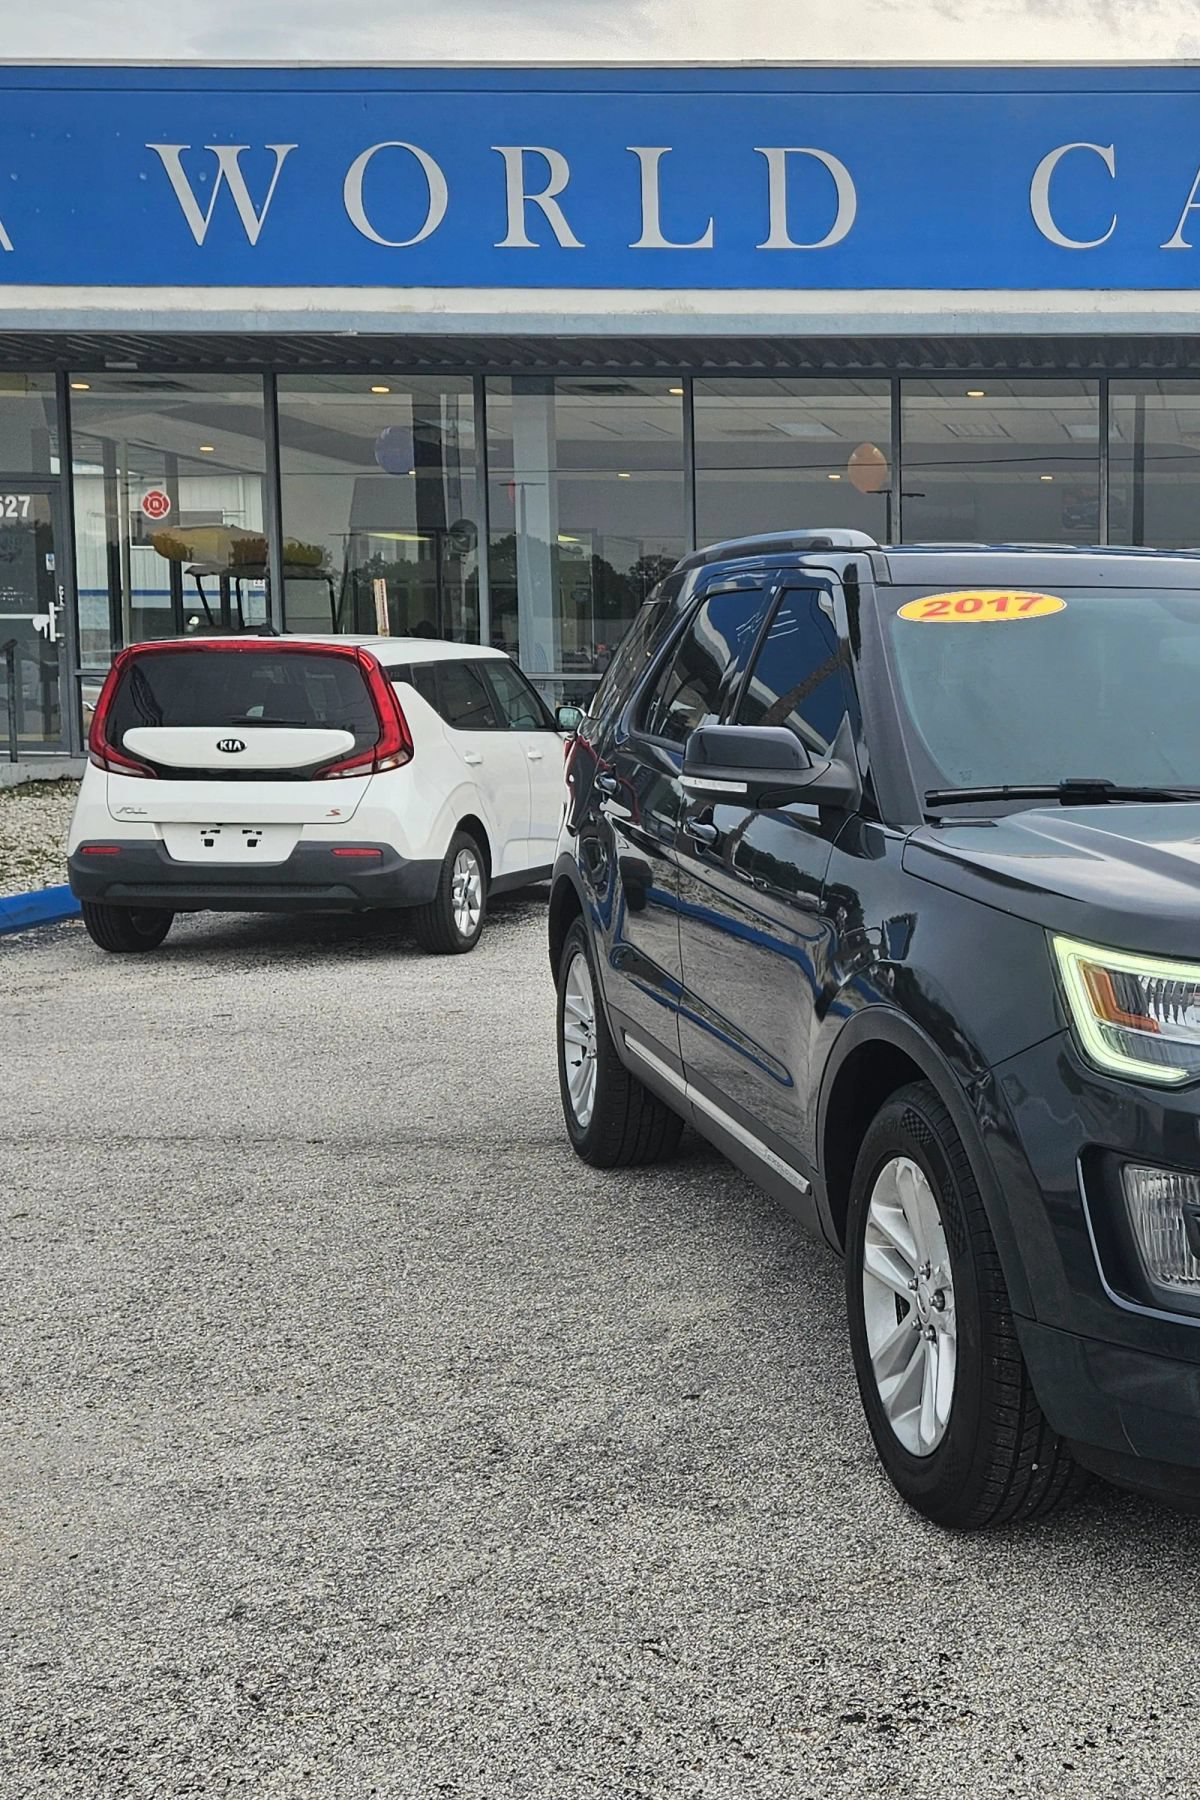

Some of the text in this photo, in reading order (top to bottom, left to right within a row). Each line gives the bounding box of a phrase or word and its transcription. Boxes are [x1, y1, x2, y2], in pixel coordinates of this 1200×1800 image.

[145, 141, 858, 250] WORLD
[0, 495, 31, 518] 27
[920, 596, 1043, 618] 2017
[219, 739, 242, 751] KIA
[326, 808, 342, 817] S
